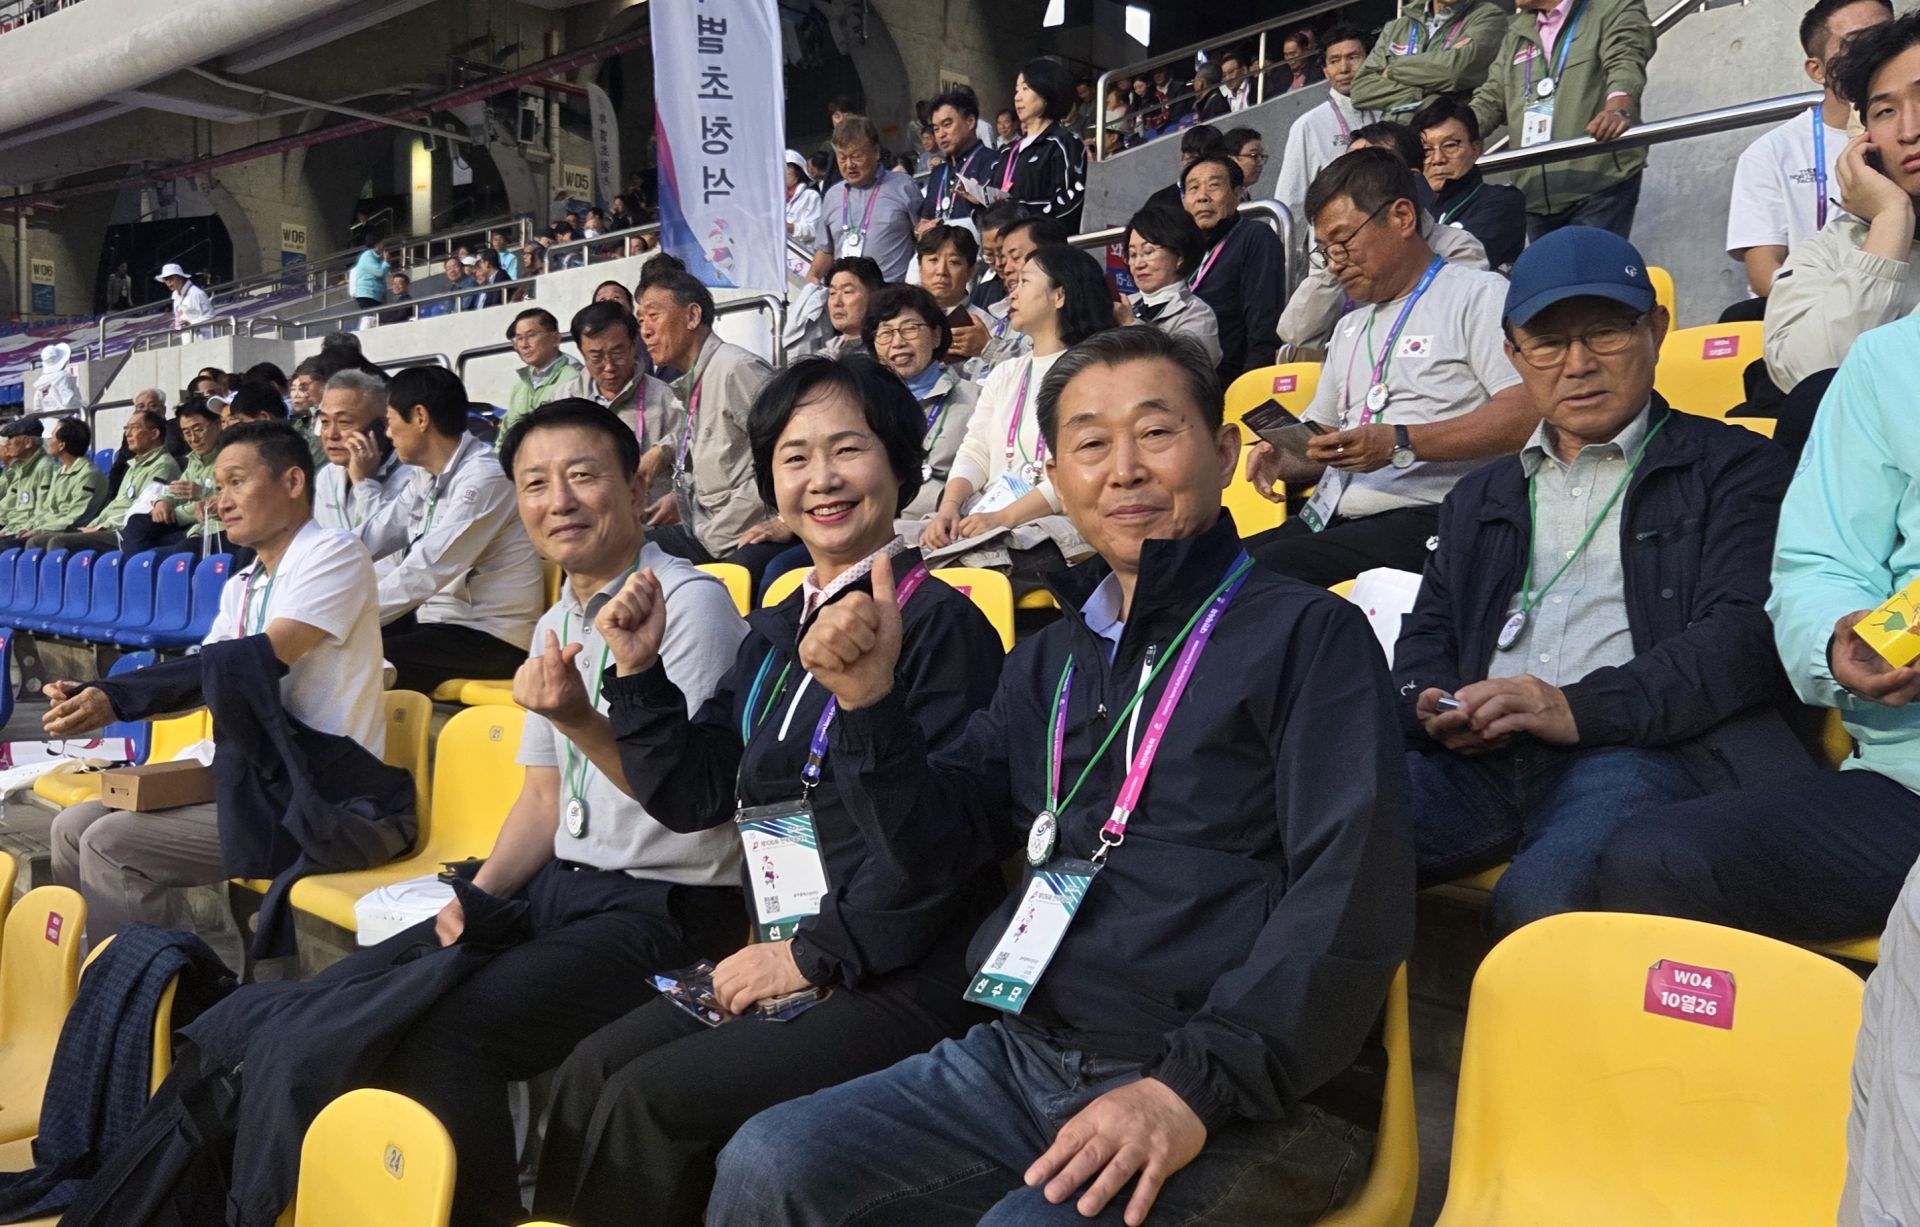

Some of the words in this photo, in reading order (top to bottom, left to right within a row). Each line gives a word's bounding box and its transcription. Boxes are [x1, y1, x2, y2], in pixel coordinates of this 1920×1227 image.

[565, 172, 590, 190] W05
[282, 228, 305, 244] W06
[33, 263, 53, 277] W06
[1674, 969, 1713, 990] W04
[1661, 991, 1717, 1016] 10열26
[389, 1149, 402, 1172] 24
